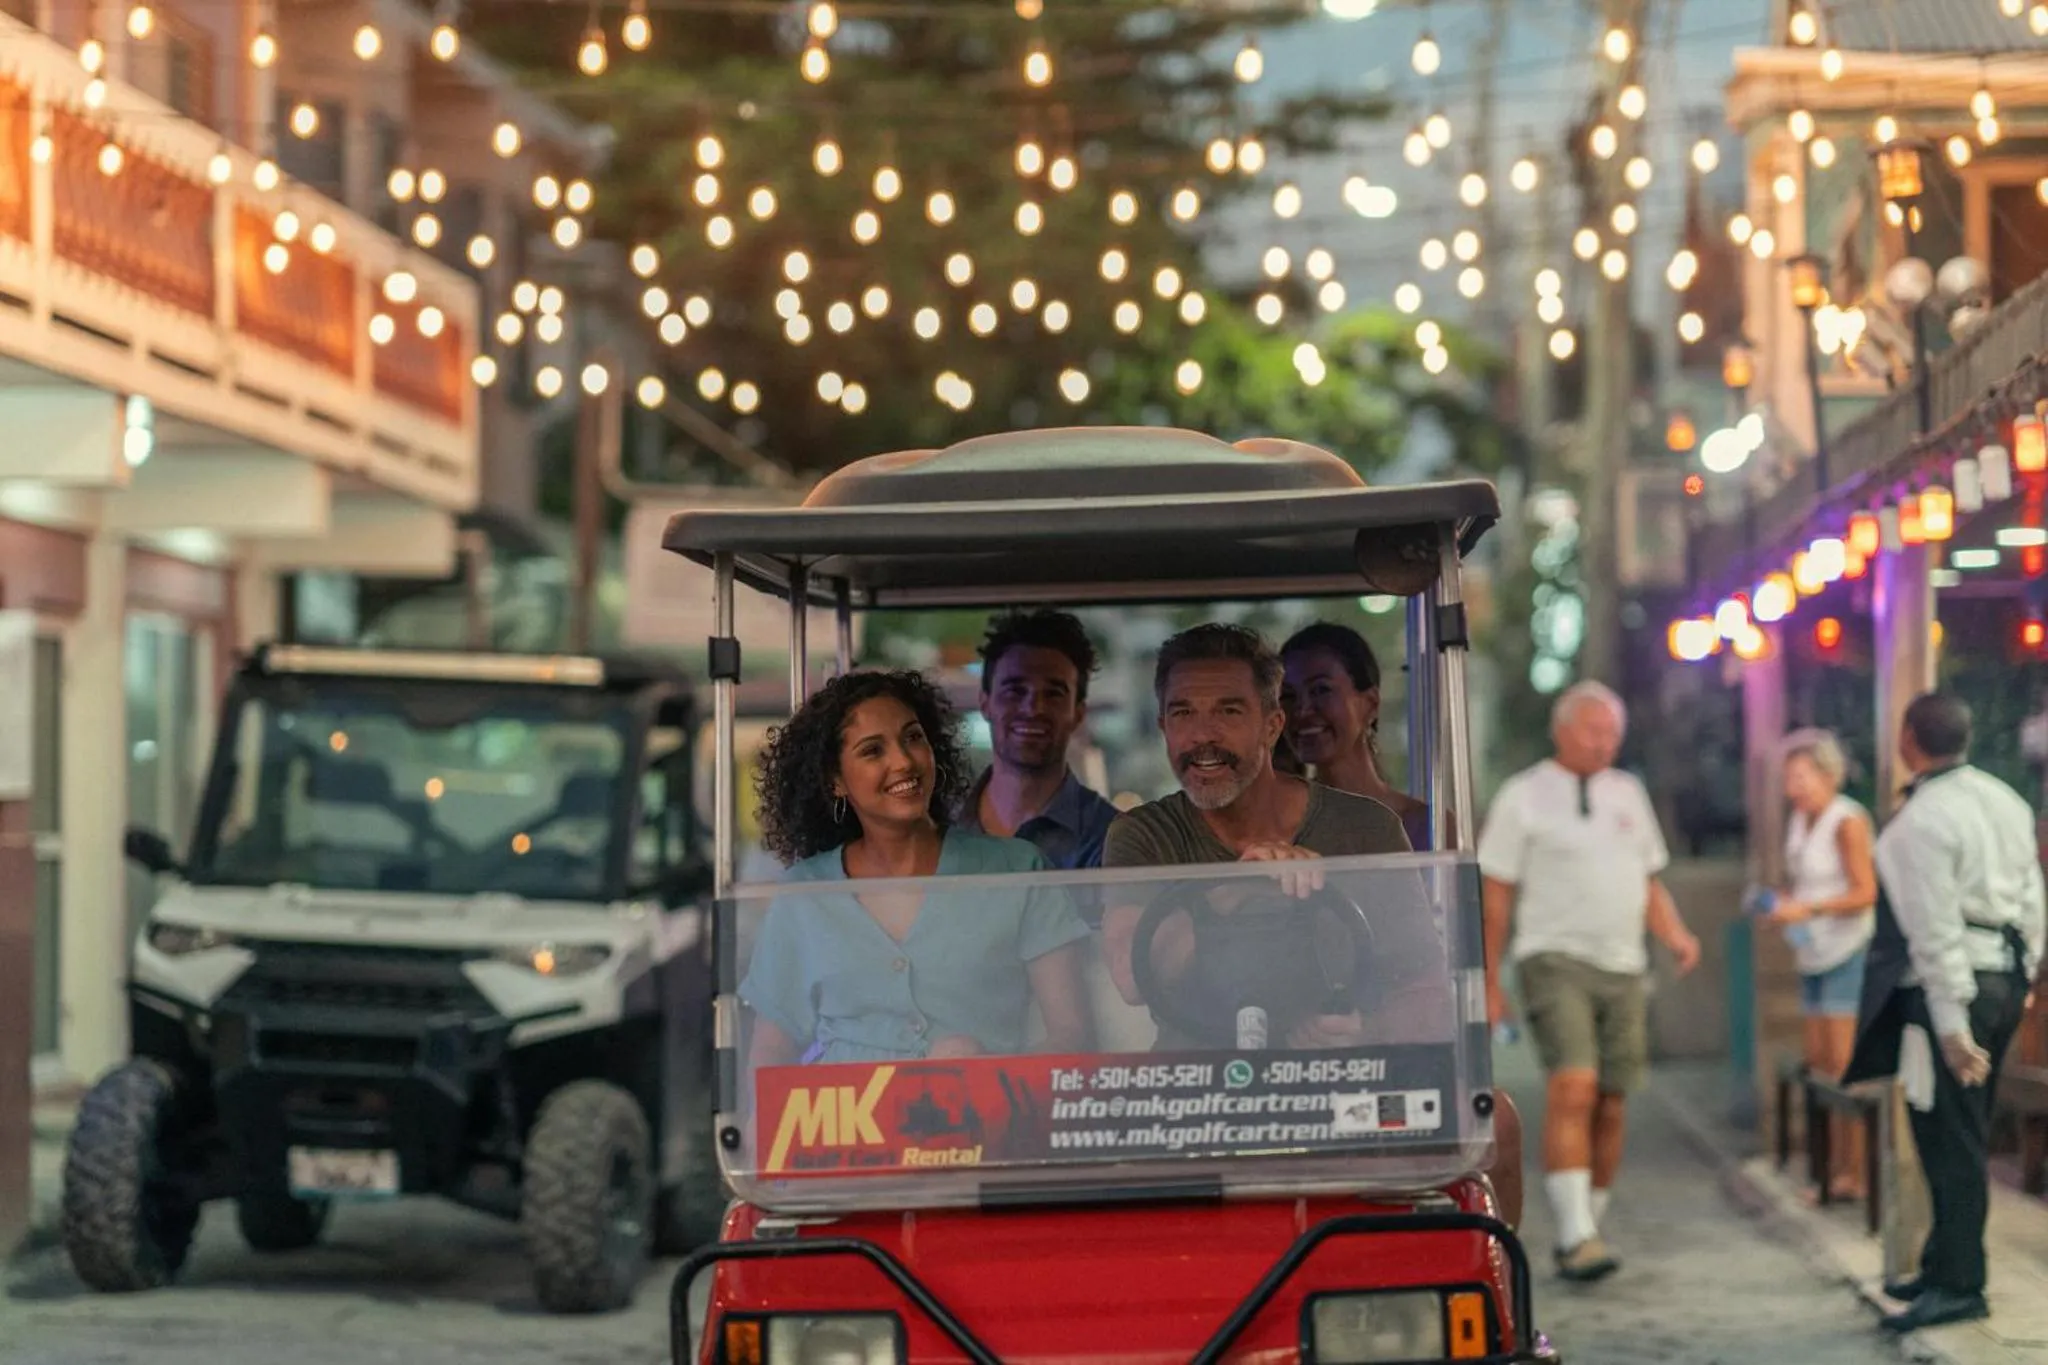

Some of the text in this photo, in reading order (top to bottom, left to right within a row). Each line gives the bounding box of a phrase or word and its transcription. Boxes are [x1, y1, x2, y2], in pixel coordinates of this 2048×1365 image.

[1050, 1068, 1084, 1092] Tel:
[765, 1066, 896, 1173] MK
[902, 1145, 983, 1166] Rental
